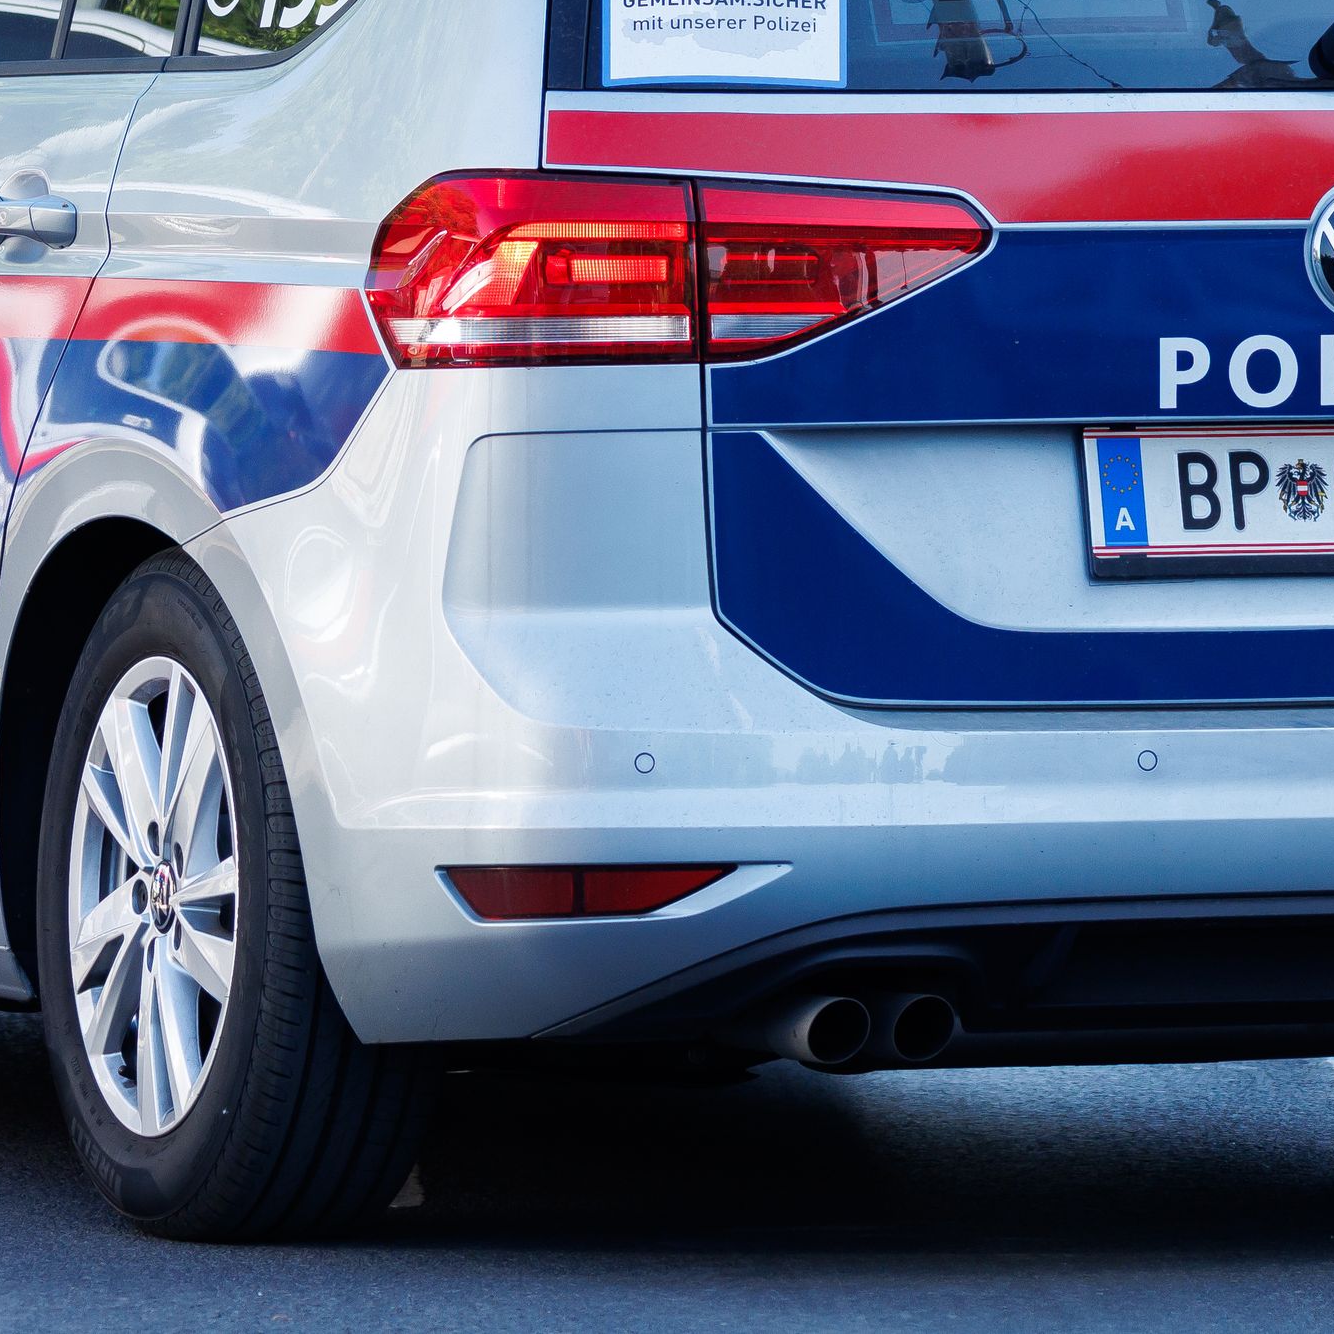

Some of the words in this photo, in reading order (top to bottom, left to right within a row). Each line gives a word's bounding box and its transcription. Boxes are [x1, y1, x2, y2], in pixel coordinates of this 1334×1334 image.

[633, 15, 664, 31] mit
[670, 16, 747, 30] unserer
[753, 15, 817, 33] Polizei
[1115, 507, 1136, 531] A
[1176, 448, 1270, 531] BP
